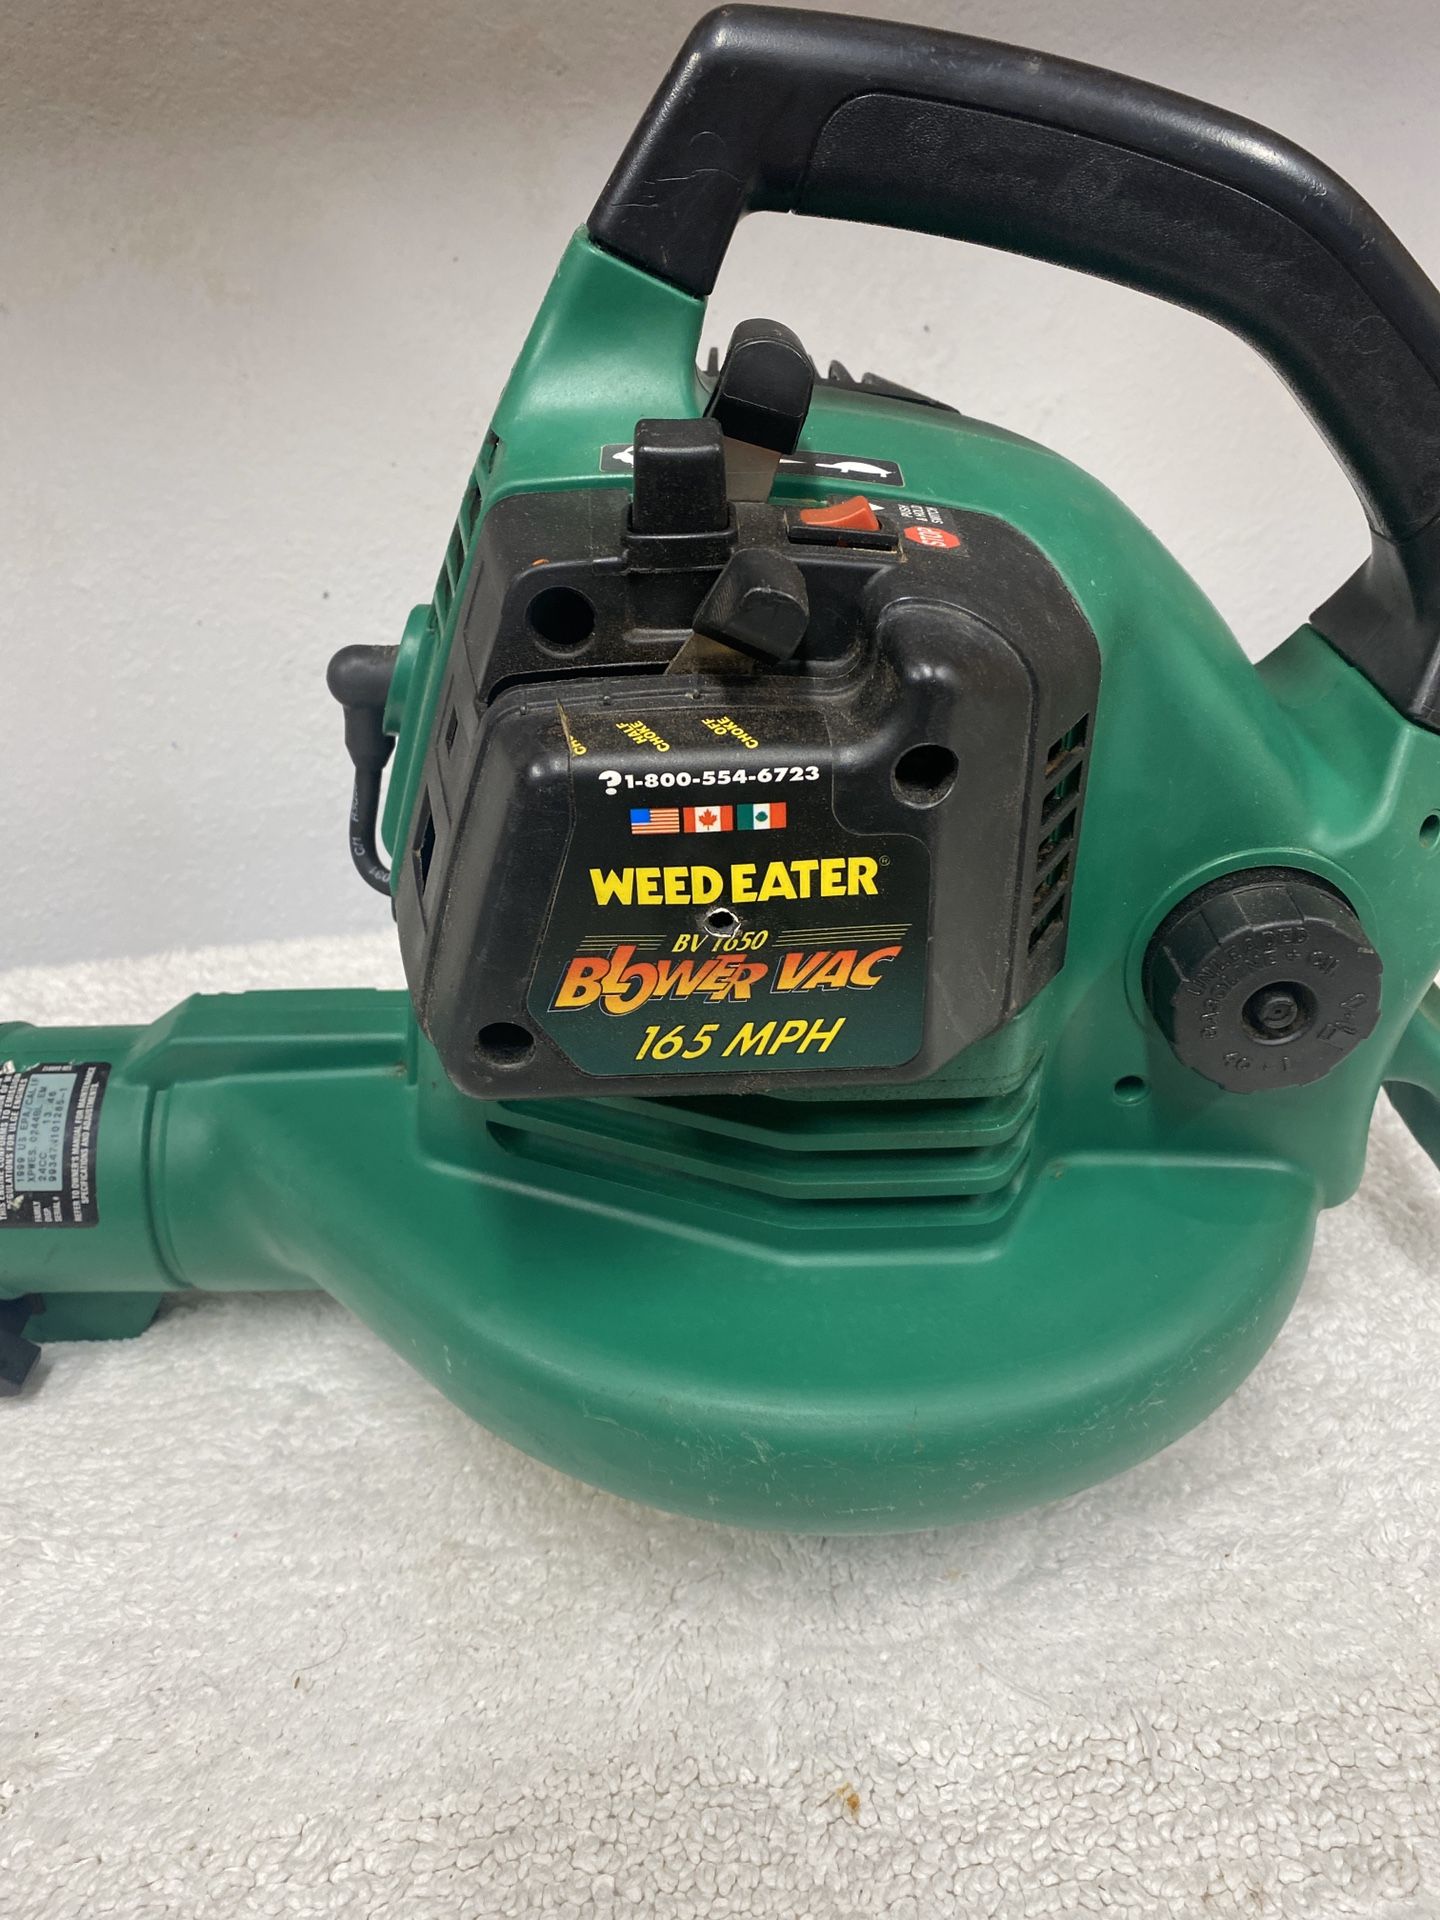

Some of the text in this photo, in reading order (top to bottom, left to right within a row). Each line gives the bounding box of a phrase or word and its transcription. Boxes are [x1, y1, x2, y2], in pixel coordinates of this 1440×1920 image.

[917, 526, 947, 547] STOP
[616, 722, 647, 745] HALF
[630, 720, 671, 753] CHOKE
[701, 718, 727, 736] OFF
[717, 716, 759, 750] CHOKE
[624, 766, 821, 789] 1-800-554-6723
[589, 855, 880, 906] WEED EATER
[671, 929, 769, 953] BV 1650
[549, 944, 903, 1017] BLOWER VAC
[635, 1017, 847, 1061] 165 MPH
[13, 1077, 28, 1110] ENGINES
[2, 1109, 11, 1120] TO
[8, 1111, 19, 1132] ULGE
[6, 1134, 15, 1151] FOR
[18, 1136, 27, 1151] US
[71, 1066, 96, 1222] REFER TO OWNER'S MANUAL FOR MAINTENANCE
[80, 1131, 90, 1147] AND
[16, 1157, 25, 1183] 1999
[39, 1151, 48, 1182] 24CC
[80, 1148, 89, 1204] SPECIFICATIONS
[32, 1200, 42, 1223] FAMILY
[53, 1201, 63, 1223] SERIAL
